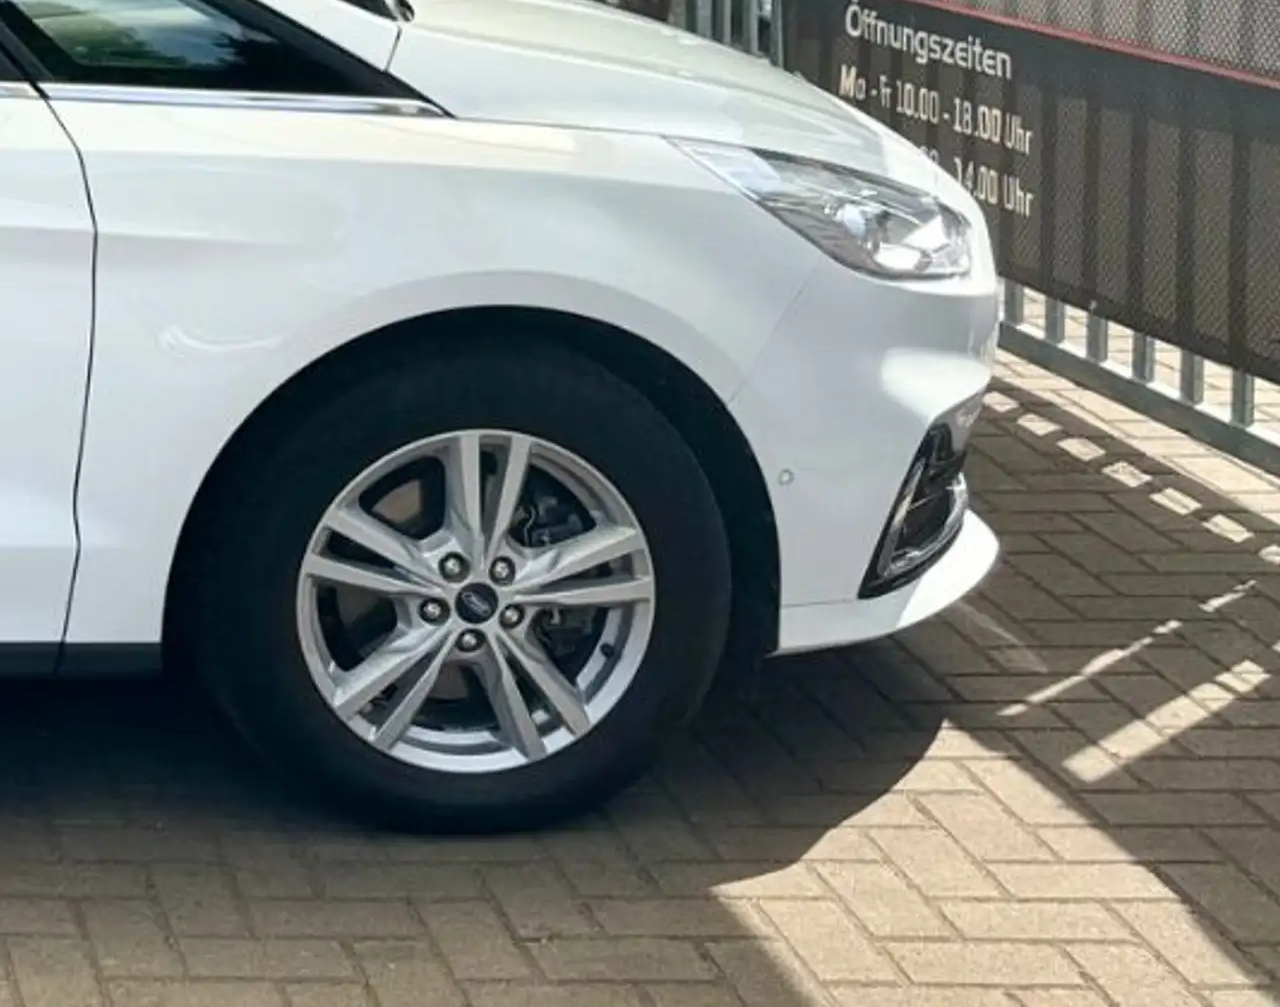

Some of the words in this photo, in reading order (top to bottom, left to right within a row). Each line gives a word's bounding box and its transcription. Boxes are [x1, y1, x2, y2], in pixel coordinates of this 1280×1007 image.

[839, 63, 866, 101] Mo
[896, 79, 940, 124] 10.00
[954, 97, 1002, 143] 18.00
[1004, 113, 1034, 154] Uhr
[1004, 173, 1035, 219] Uhr
